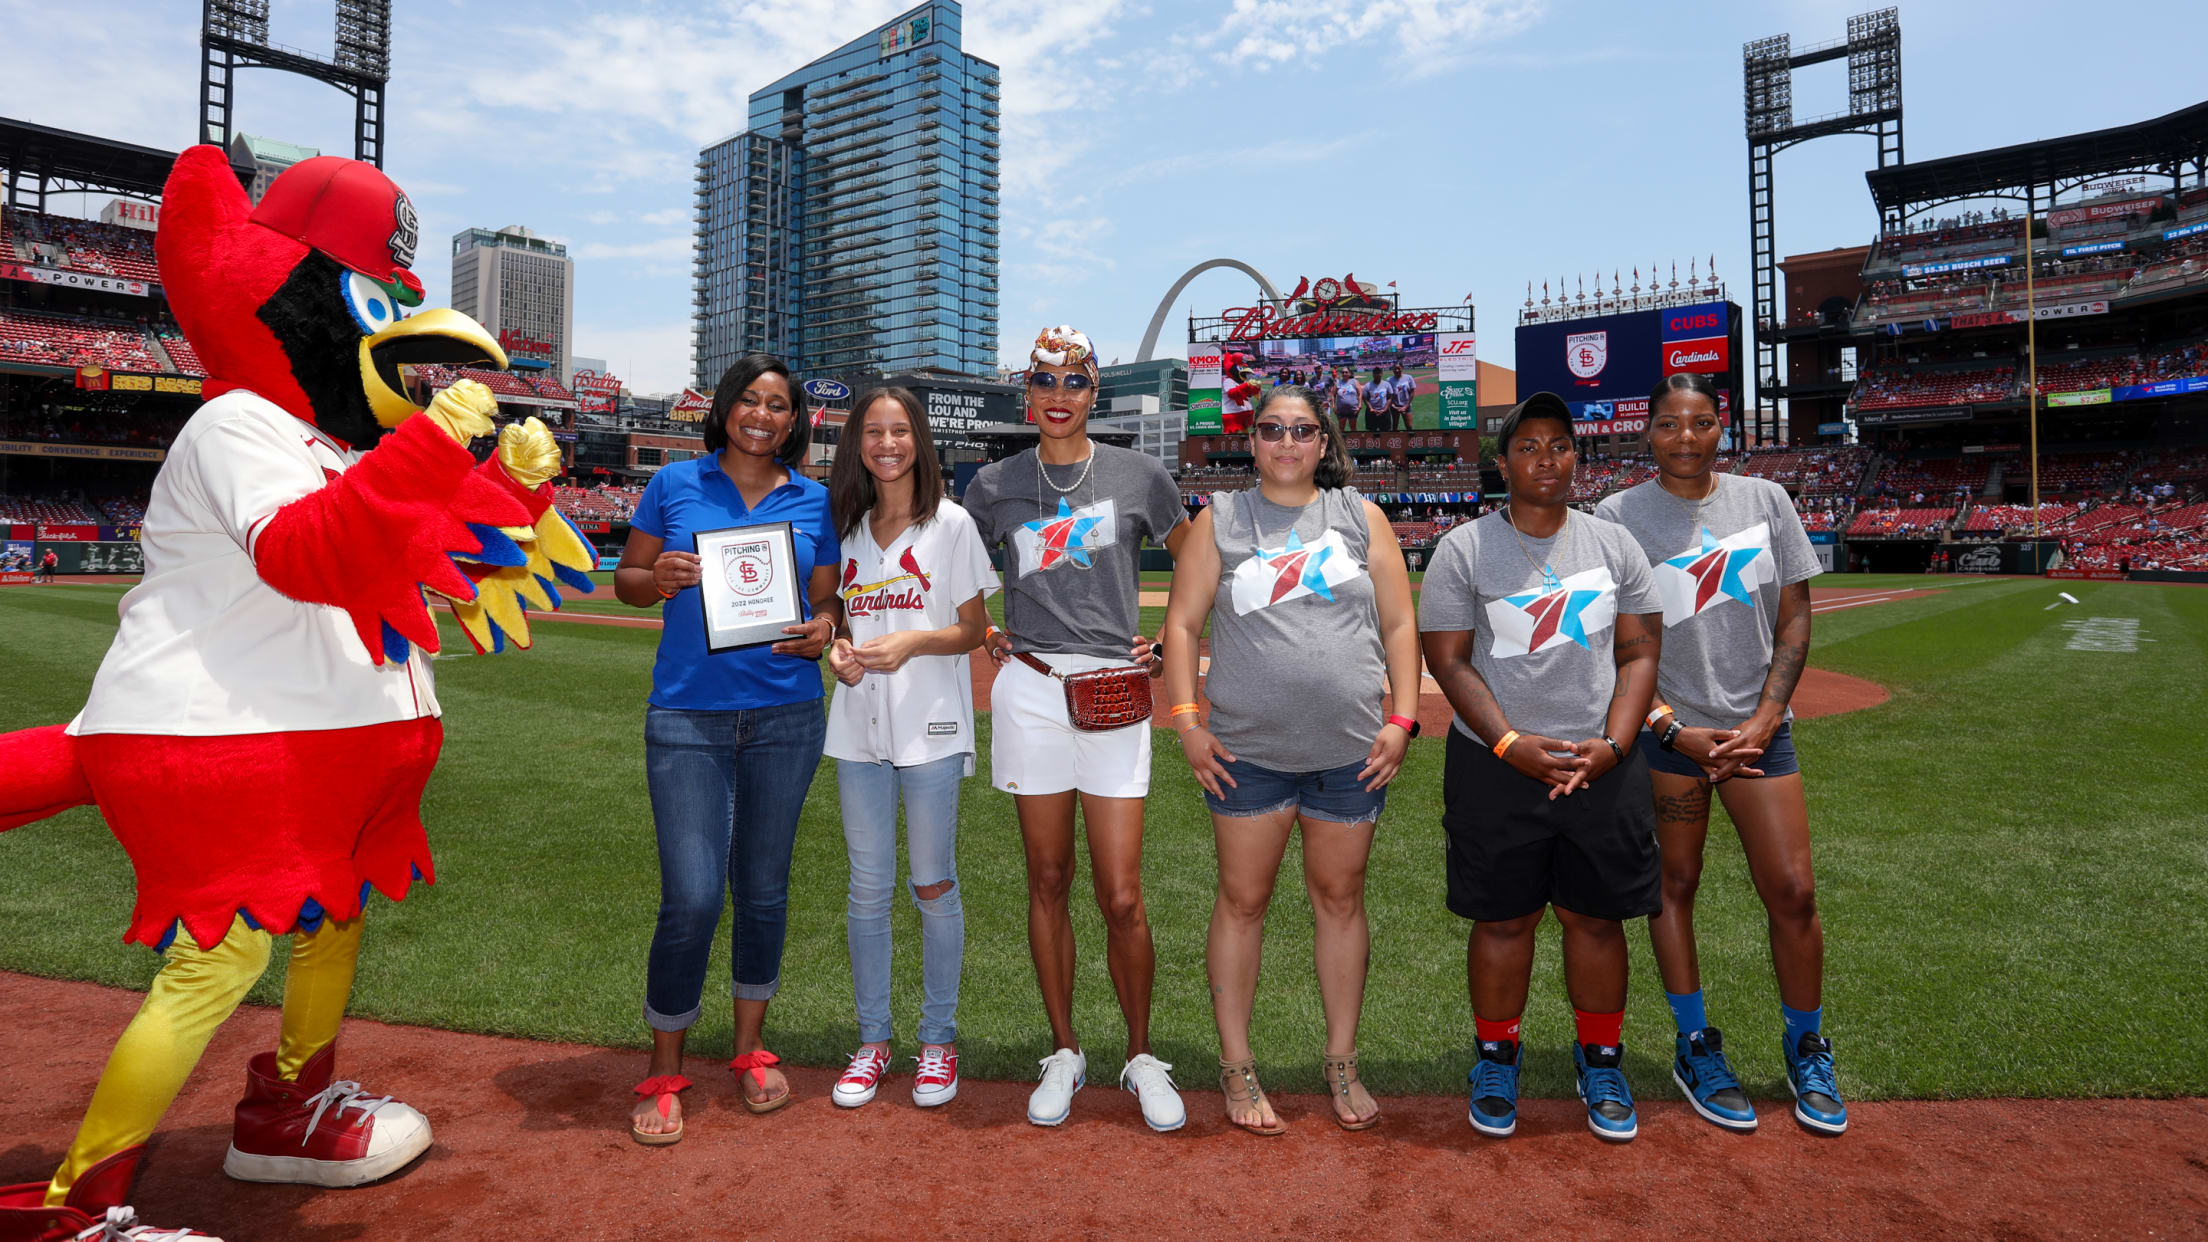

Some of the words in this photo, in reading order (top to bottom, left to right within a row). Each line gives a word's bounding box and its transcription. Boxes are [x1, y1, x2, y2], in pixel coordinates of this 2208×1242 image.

[2082, 176, 2146, 192] BUDWEISER
[118, 202, 158, 222] Hil
[2091, 200, 2156, 216] BUDWEISER
[2100, 242, 2121, 250] PITCH
[1952, 261, 1981, 270] BUSCH
[1984, 257, 2006, 266] BEER
[53, 273, 125, 290] POWER
[1537, 304, 1598, 320] WORLD
[1600, 289, 1705, 311] CHAMPIONS
[1222, 305, 1438, 340] Budweiser
[1670, 314, 1718, 331] CUBS
[1954, 316, 1992, 327] THAT'S
[498, 328, 552, 354] Nation
[1569, 334, 1599, 343] PITCHING
[1189, 356, 1220, 364] KMOX
[1670, 350, 1719, 367] Cardinals
[1100, 369, 1132, 378] POLSINELLI
[573, 369, 623, 396] Bally
[814, 381, 842, 396] Ford
[581, 398, 615, 413] Live!
[928, 393, 961, 405] FROM
[964, 397, 984, 407] THE
[1618, 402, 1648, 412] BUILDI
[670, 409, 705, 423] BREW
[928, 405, 951, 416] LOU
[953, 407, 977, 418] AND
[928, 417, 964, 429] WE'RE
[967, 420, 1004, 430] PRO
[1574, 423, 1598, 435] WN
[1601, 425, 1610, 433] &
[1613, 419, 1648, 432] CRO
[1346, 438, 1360, 449] 23
[42, 446, 100, 456] CONVENIENCE
[110, 449, 158, 458] EXPERIENCE
[724, 545, 761, 556] PITCHING
[748, 597, 774, 606] HONOREE
[847, 588, 924, 617] Cardinals
